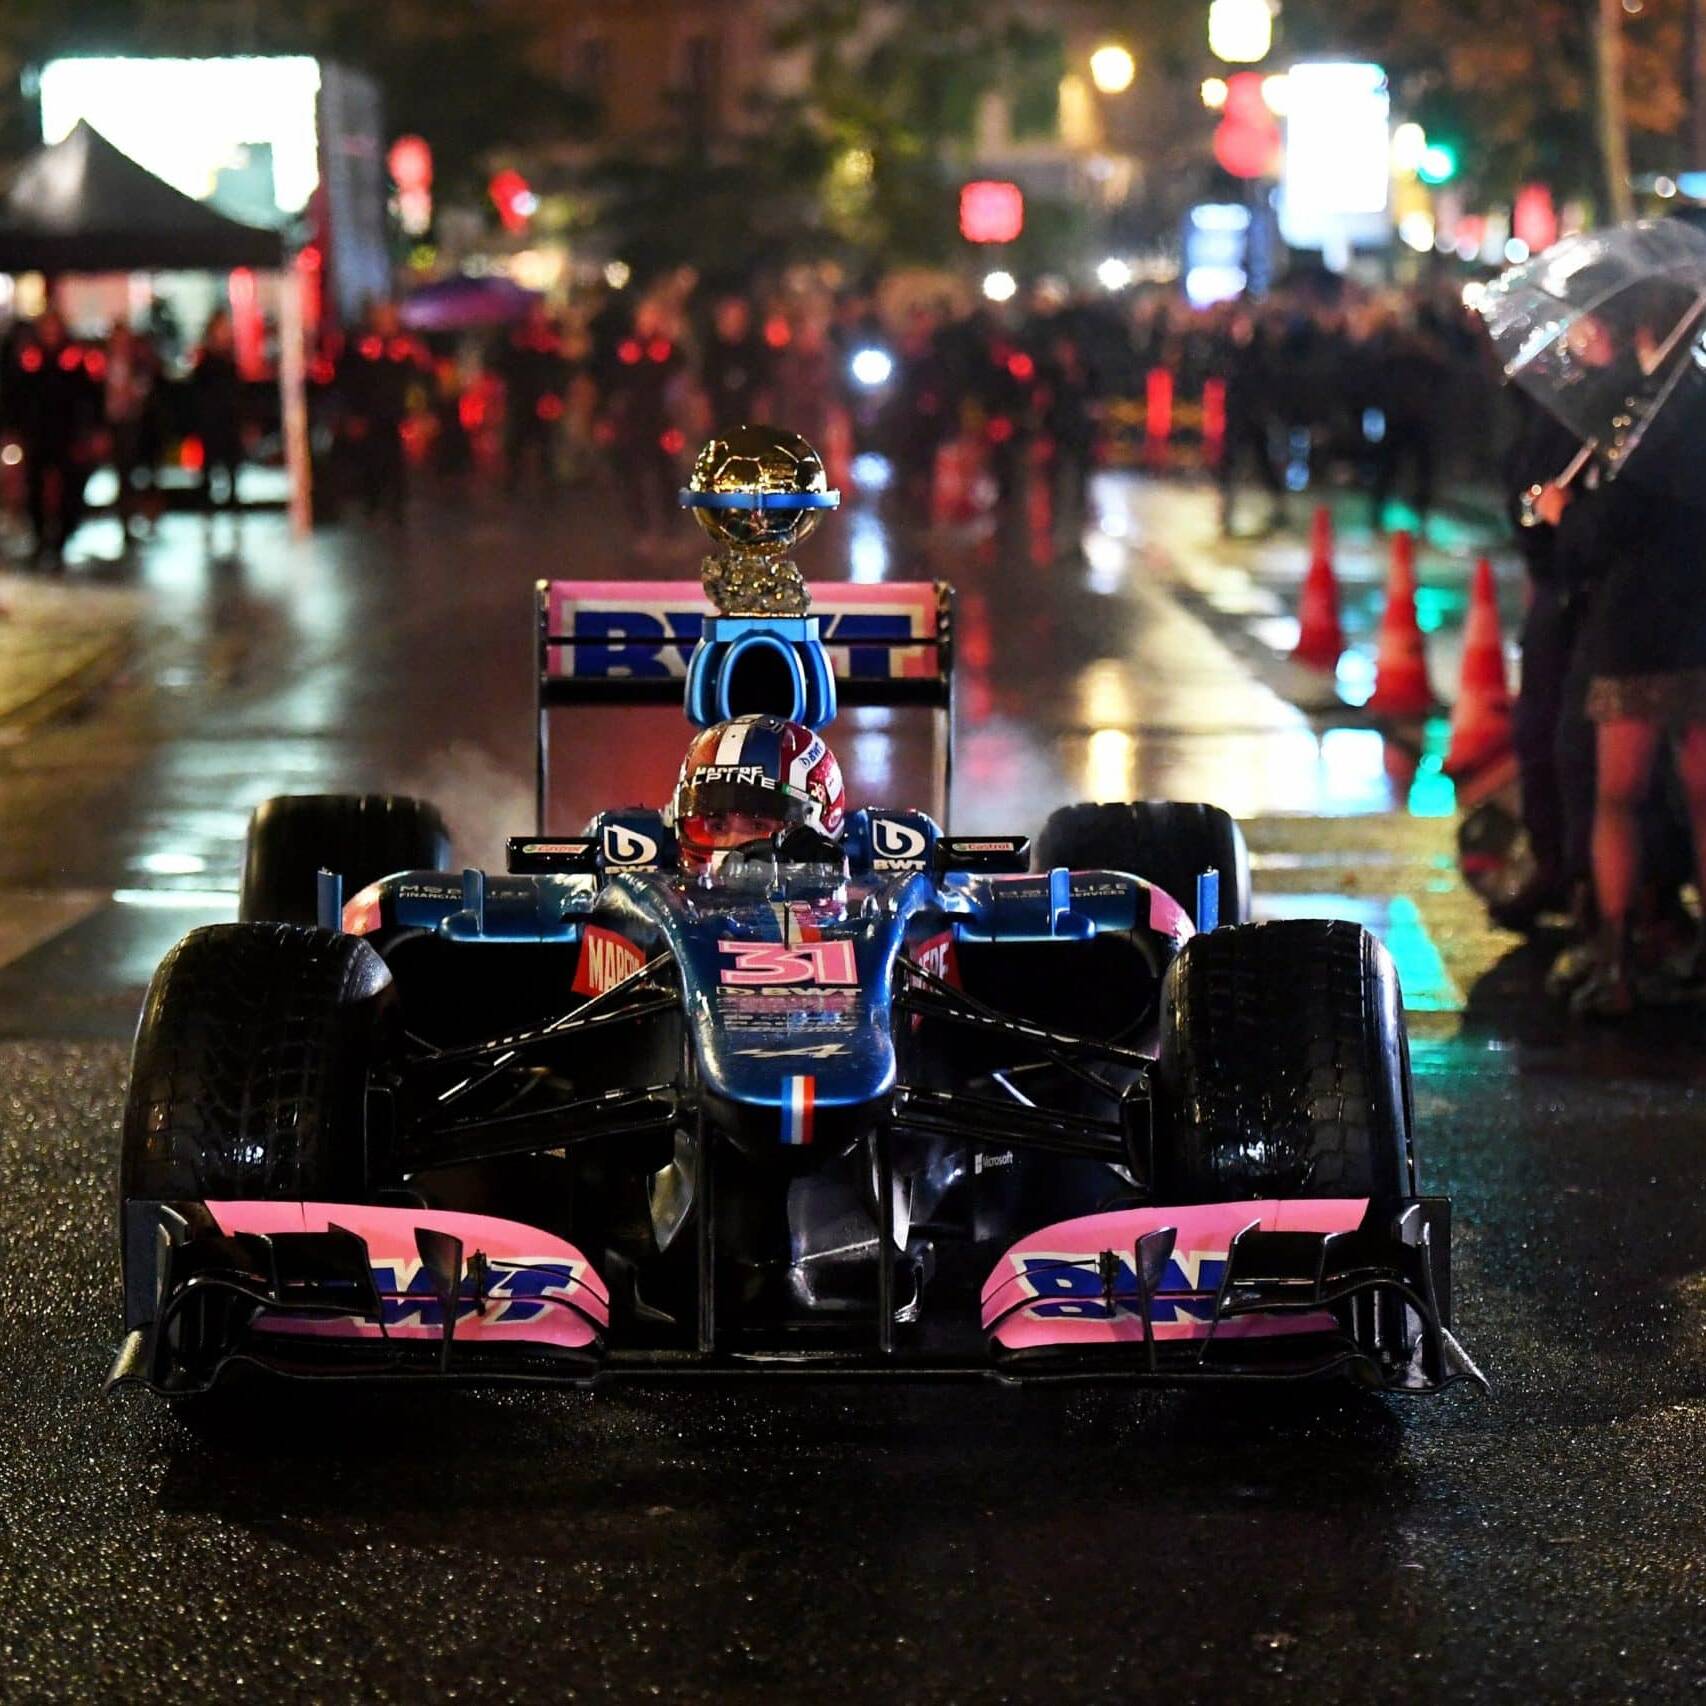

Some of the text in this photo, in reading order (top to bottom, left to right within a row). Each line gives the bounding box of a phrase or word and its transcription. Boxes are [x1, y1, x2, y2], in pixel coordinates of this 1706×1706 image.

[573, 611, 912, 678] BT
[872, 859, 926, 871] BWT
[718, 940, 858, 984] 31
[983, 1150, 1014, 1168] Microsoft
